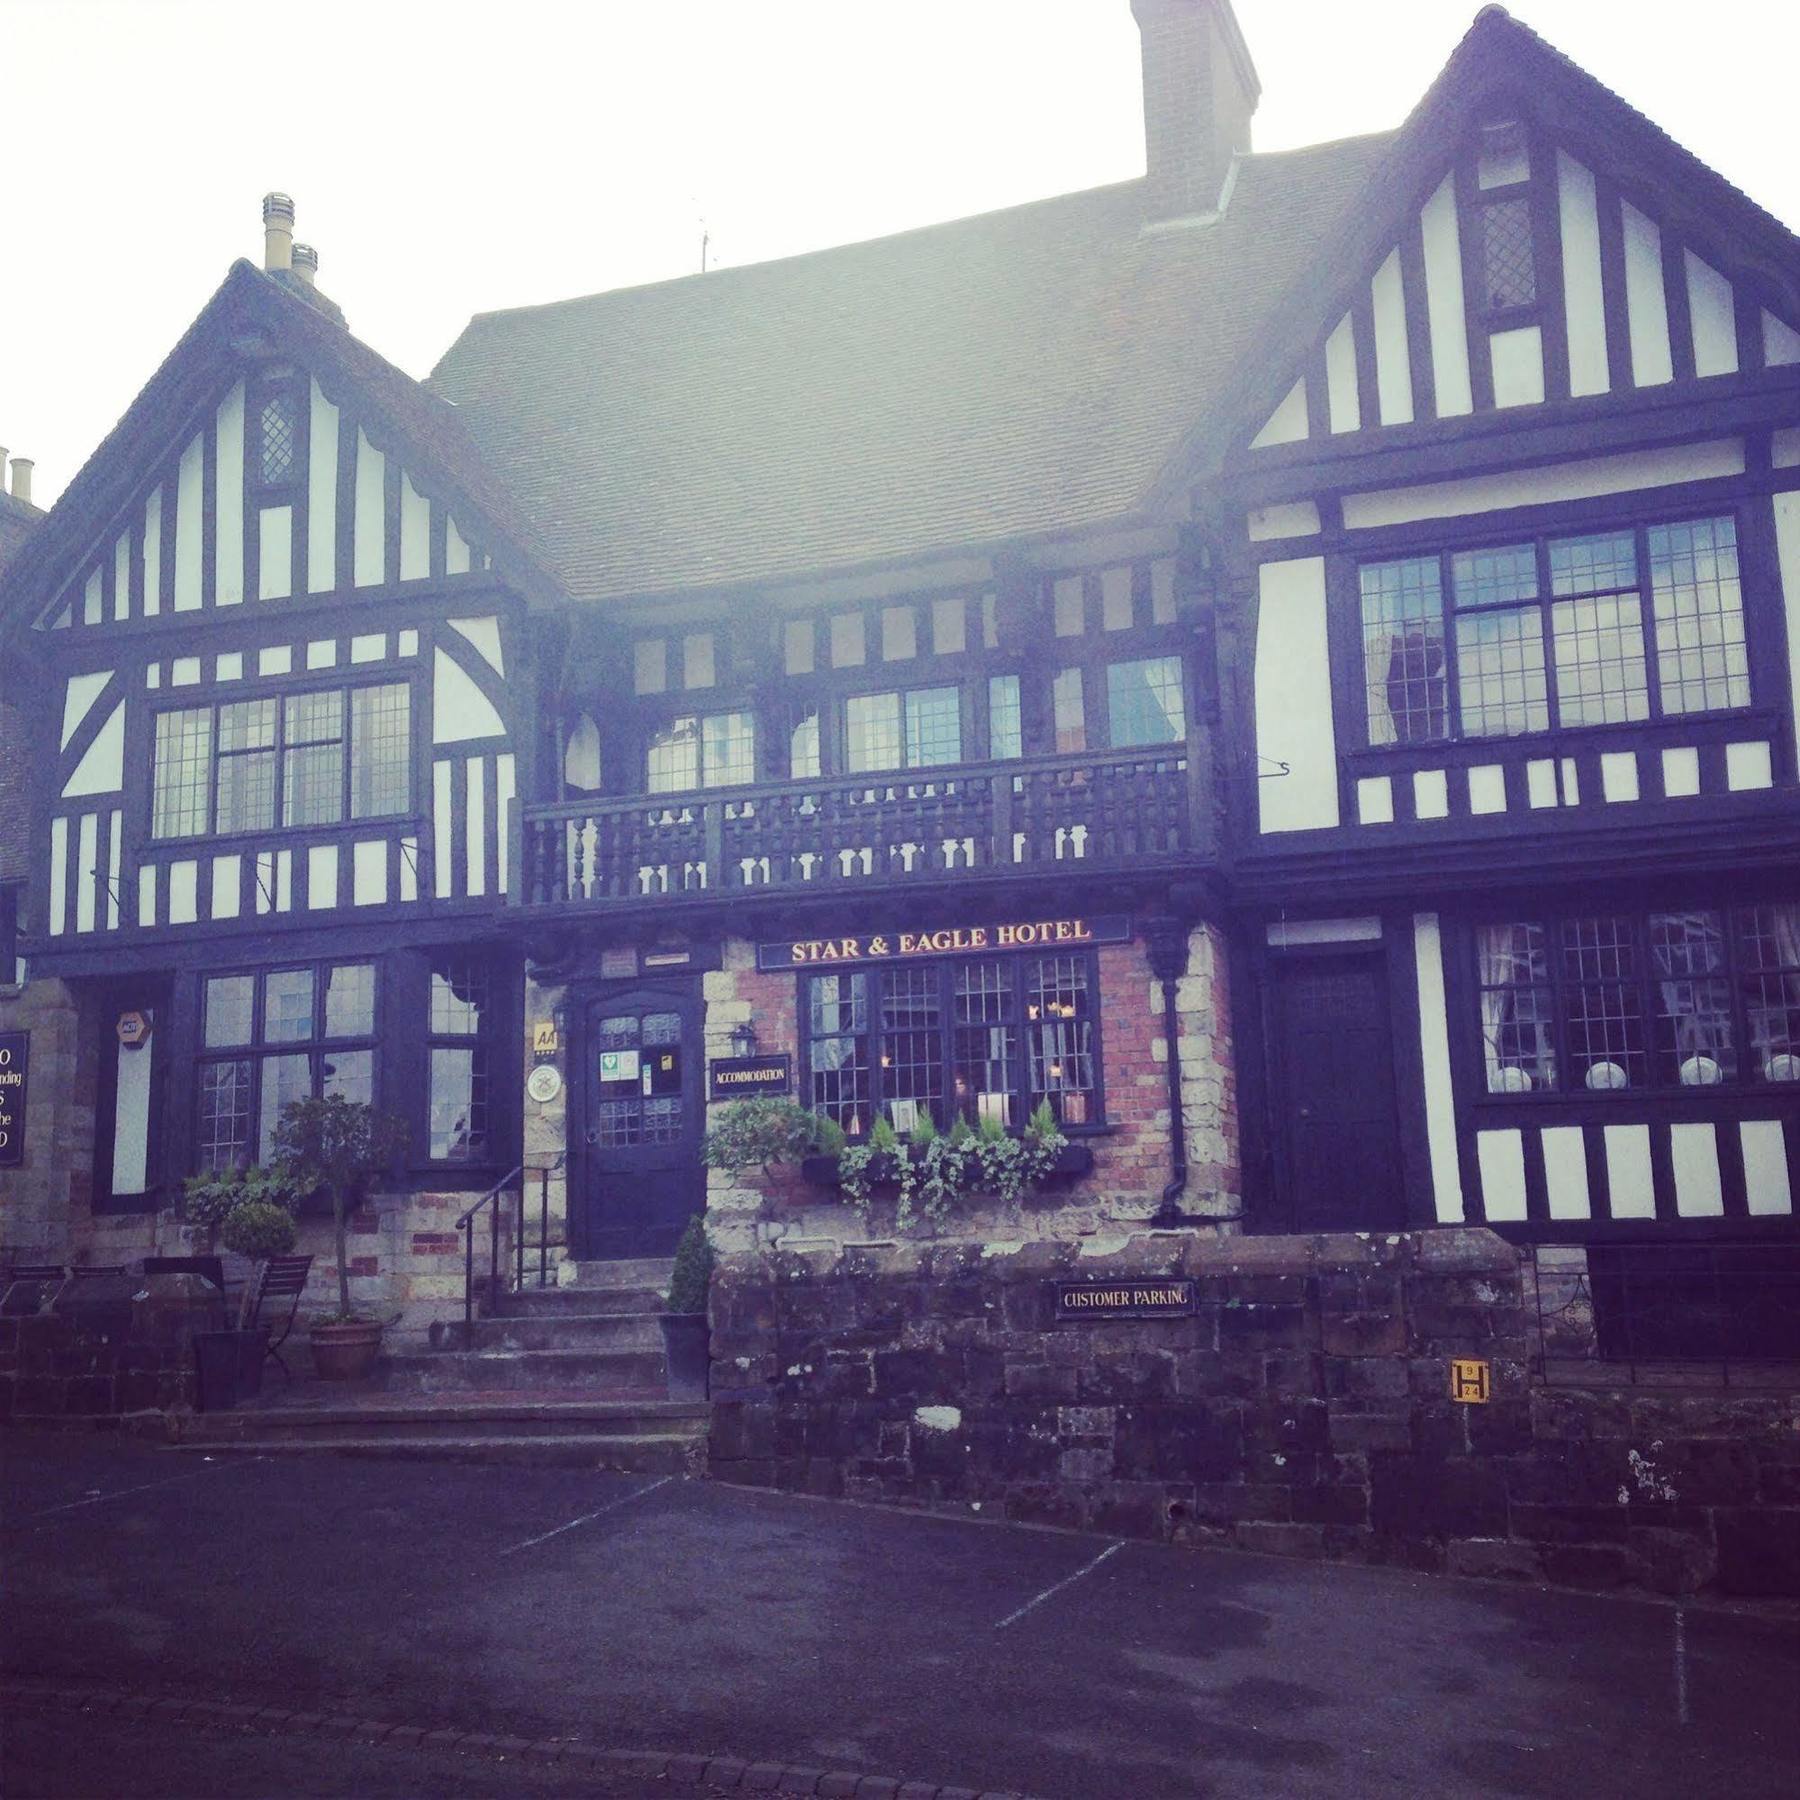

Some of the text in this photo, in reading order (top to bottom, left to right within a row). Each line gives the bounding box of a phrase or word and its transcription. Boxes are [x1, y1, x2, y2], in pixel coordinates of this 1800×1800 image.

[791, 920, 1091, 961] STAR & EAGLE HOTEL
[538, 1031, 554, 1045] AA
[716, 1068, 785, 1084] ACCOMMODATION
[1064, 1289, 1188, 1308] CUSTOMER PARKING
[1466, 1366, 1473, 1375] 9
[1457, 1365, 1485, 1399] H
[1464, 1386, 1478, 1396] 24
